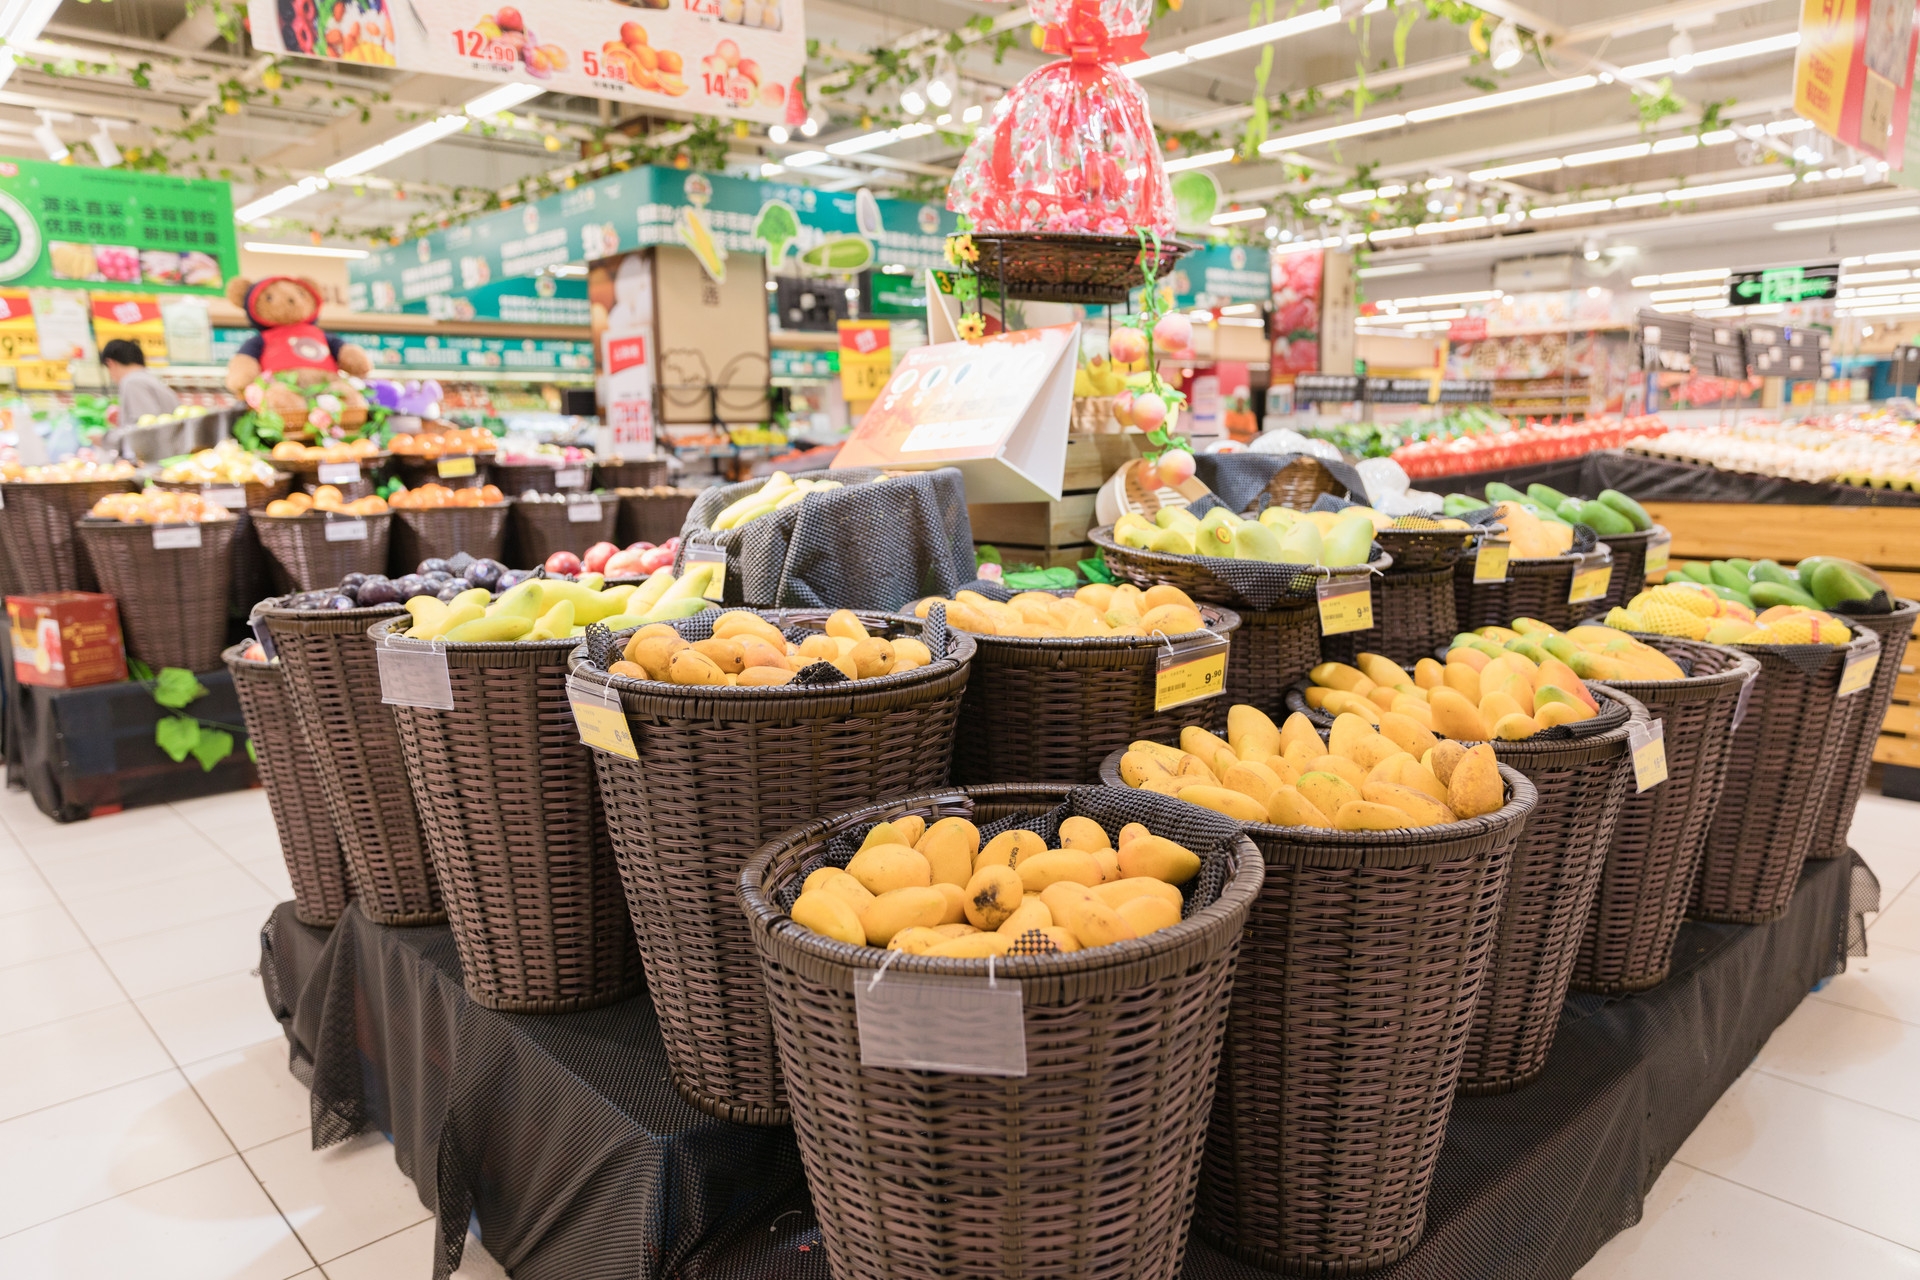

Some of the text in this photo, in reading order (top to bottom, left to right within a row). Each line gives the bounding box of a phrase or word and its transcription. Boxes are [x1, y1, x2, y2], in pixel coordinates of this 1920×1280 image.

[452, 29, 515, 63] 12.90
[582, 50, 626, 80] 5.98
[1204, 669, 1222, 684] 9.90
